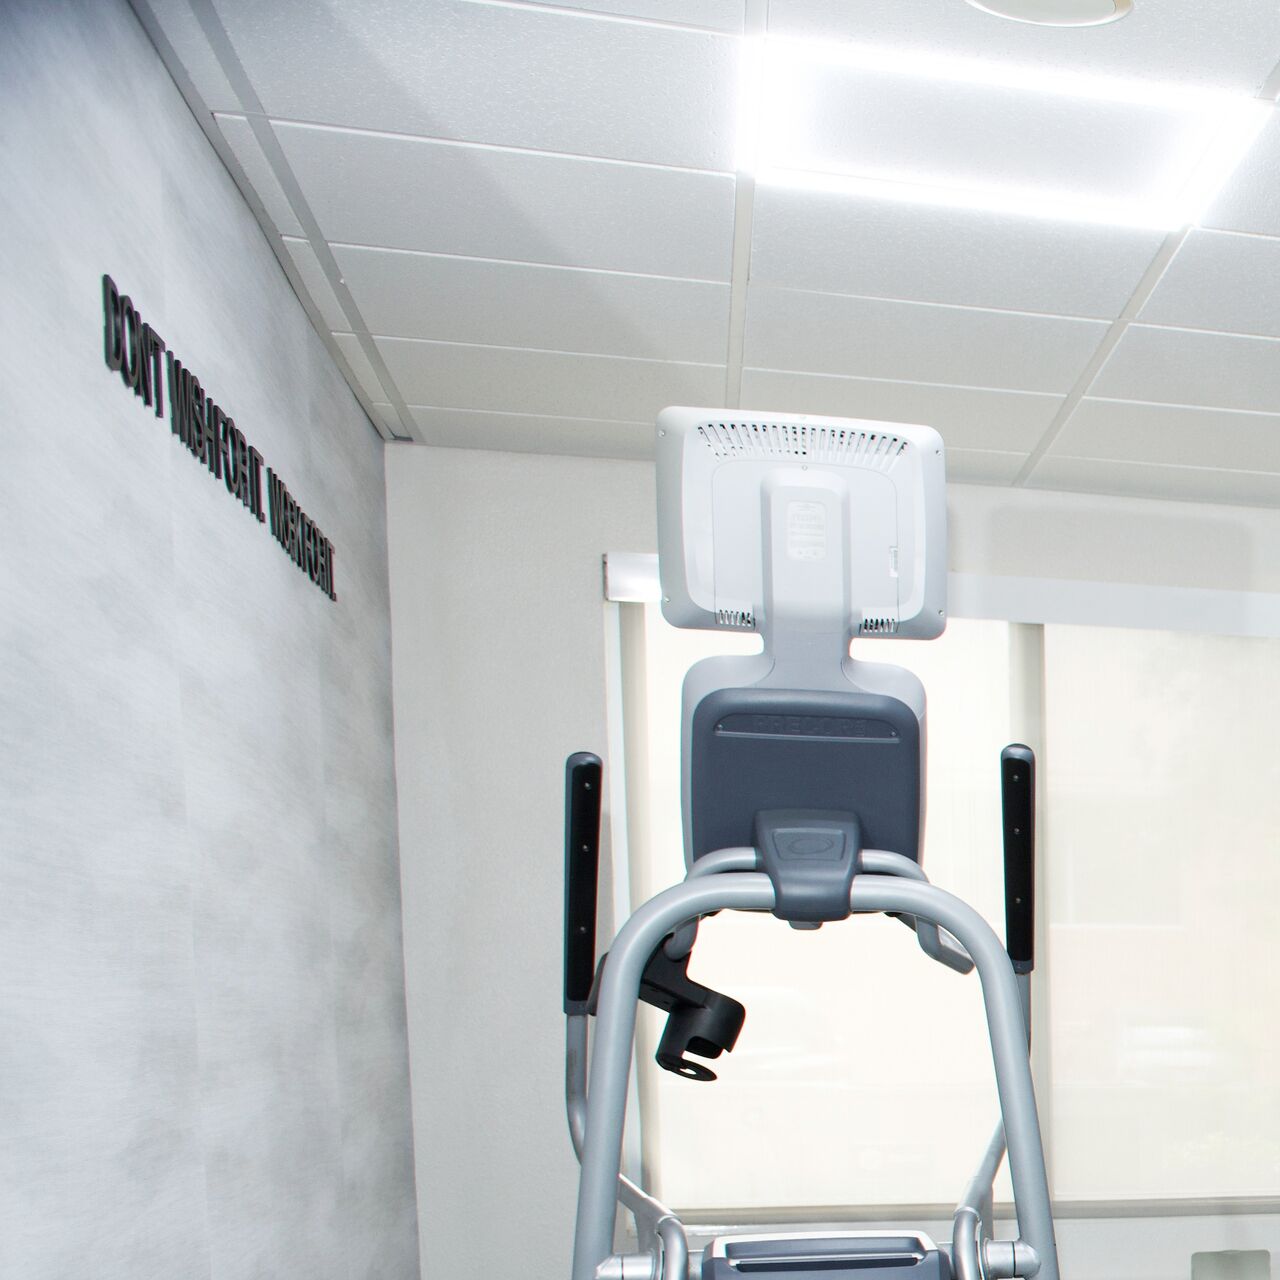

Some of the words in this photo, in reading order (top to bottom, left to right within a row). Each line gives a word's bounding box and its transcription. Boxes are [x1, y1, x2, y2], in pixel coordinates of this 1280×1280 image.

[166, 350, 213, 472] WISH
[212, 403, 249, 507] FOR
[266, 467, 302, 566] WORK
[300, 512, 326, 590] FOR
